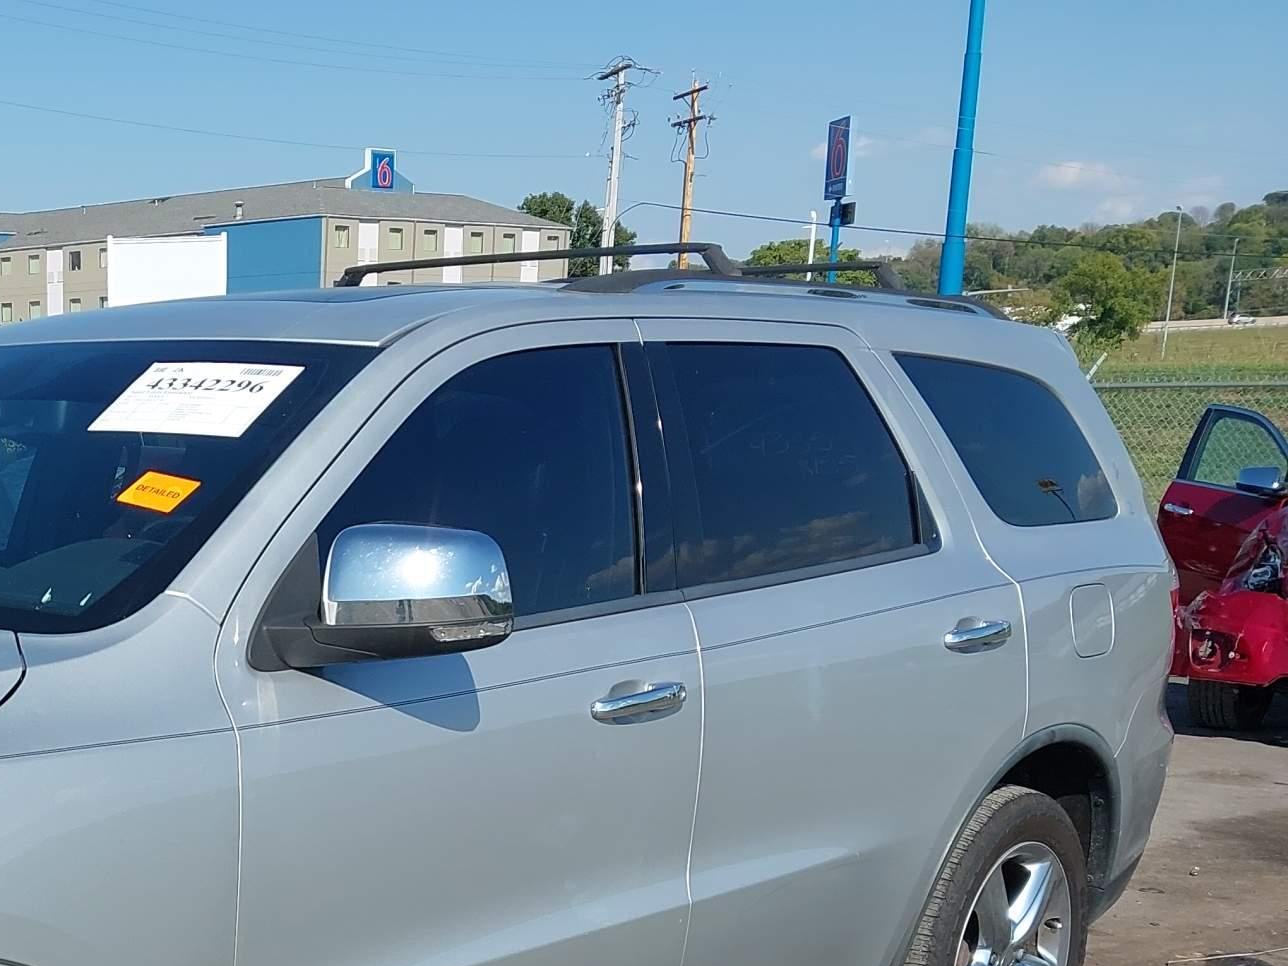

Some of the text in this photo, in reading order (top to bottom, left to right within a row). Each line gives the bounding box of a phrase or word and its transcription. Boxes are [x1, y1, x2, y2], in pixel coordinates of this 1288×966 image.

[830, 119, 848, 180] 6
[377, 157, 392, 188] 6
[146, 377, 270, 394] 43342296
[134, 482, 181, 501] DETAILED
